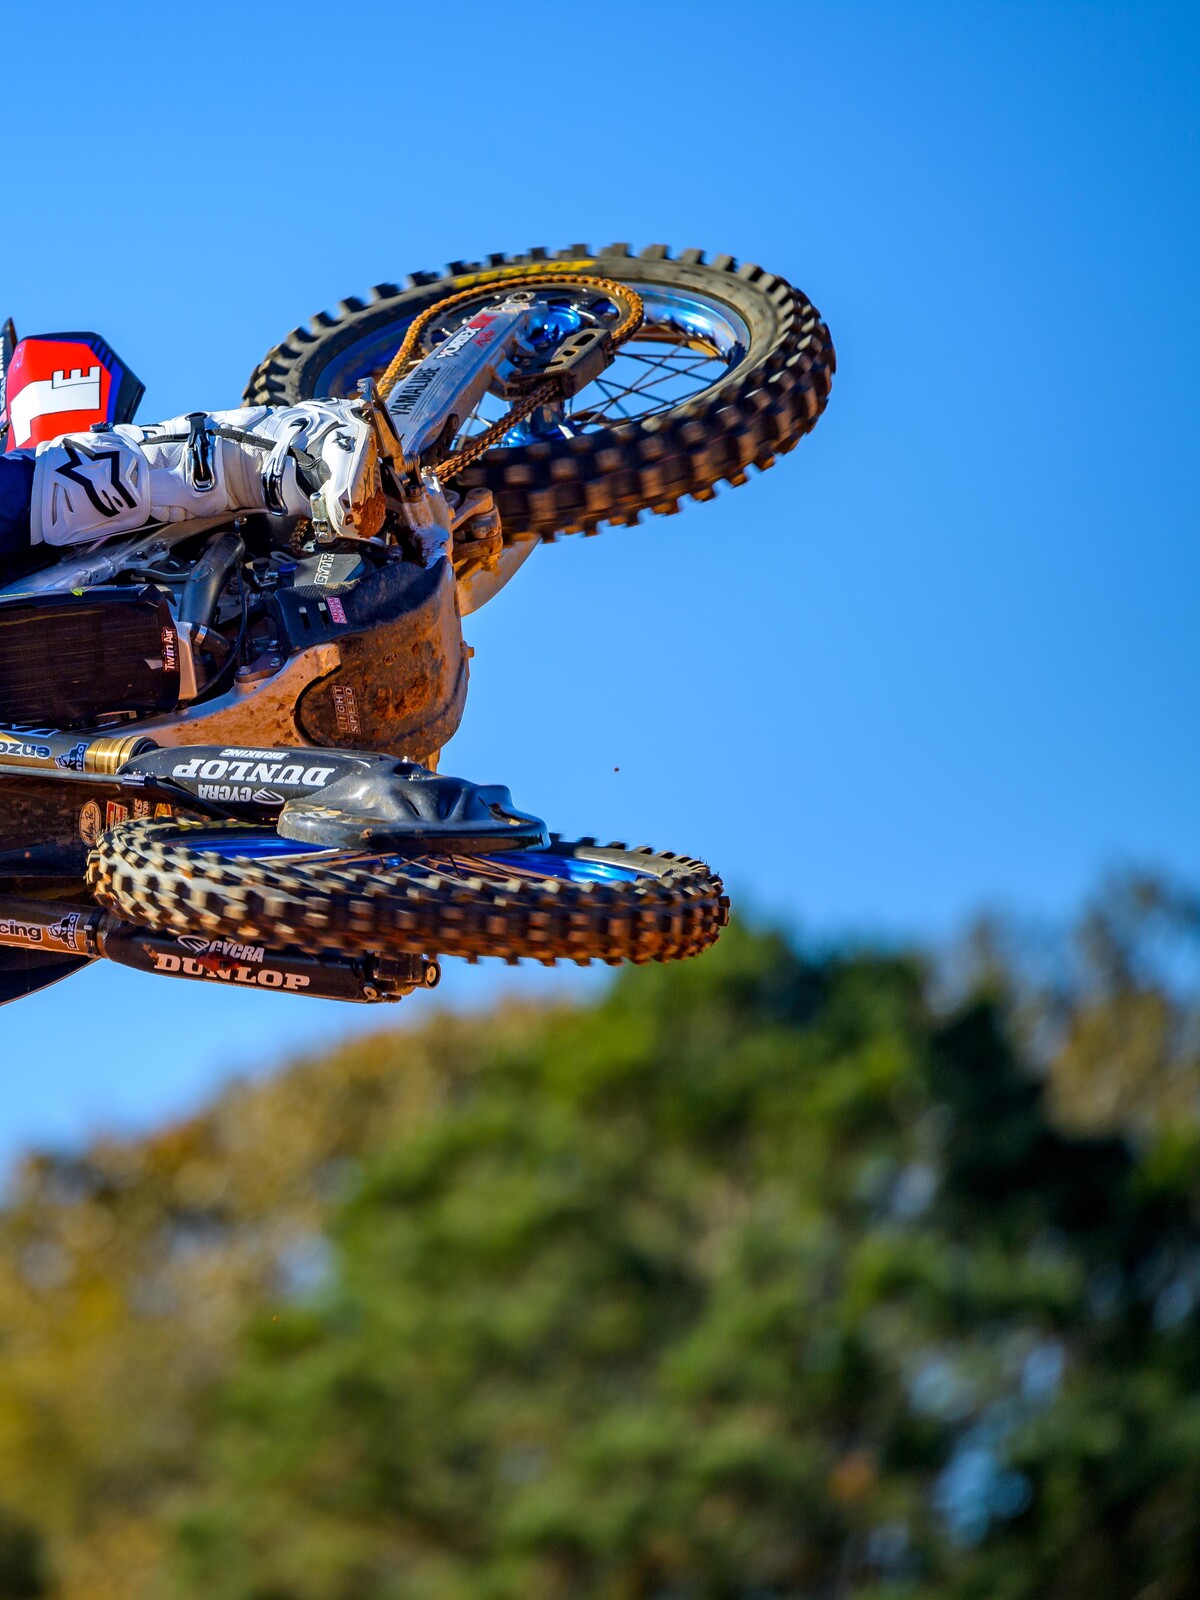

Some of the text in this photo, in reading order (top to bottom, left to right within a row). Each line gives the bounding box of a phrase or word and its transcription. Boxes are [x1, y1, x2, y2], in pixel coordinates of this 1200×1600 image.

[436, 326, 482, 360] VORTEX
[390, 366, 442, 416] YAMALUBE
[313, 553, 336, 585] GYTR
[163, 628, 176, 671] Twin Air
[334, 684, 359, 734] LIGHT SPEED
[219, 749, 290, 761] BRAKING
[172, 758, 336, 787] DUNLOP
[198, 784, 252, 803] CYCRA
[207, 940, 265, 963] CYCRA
